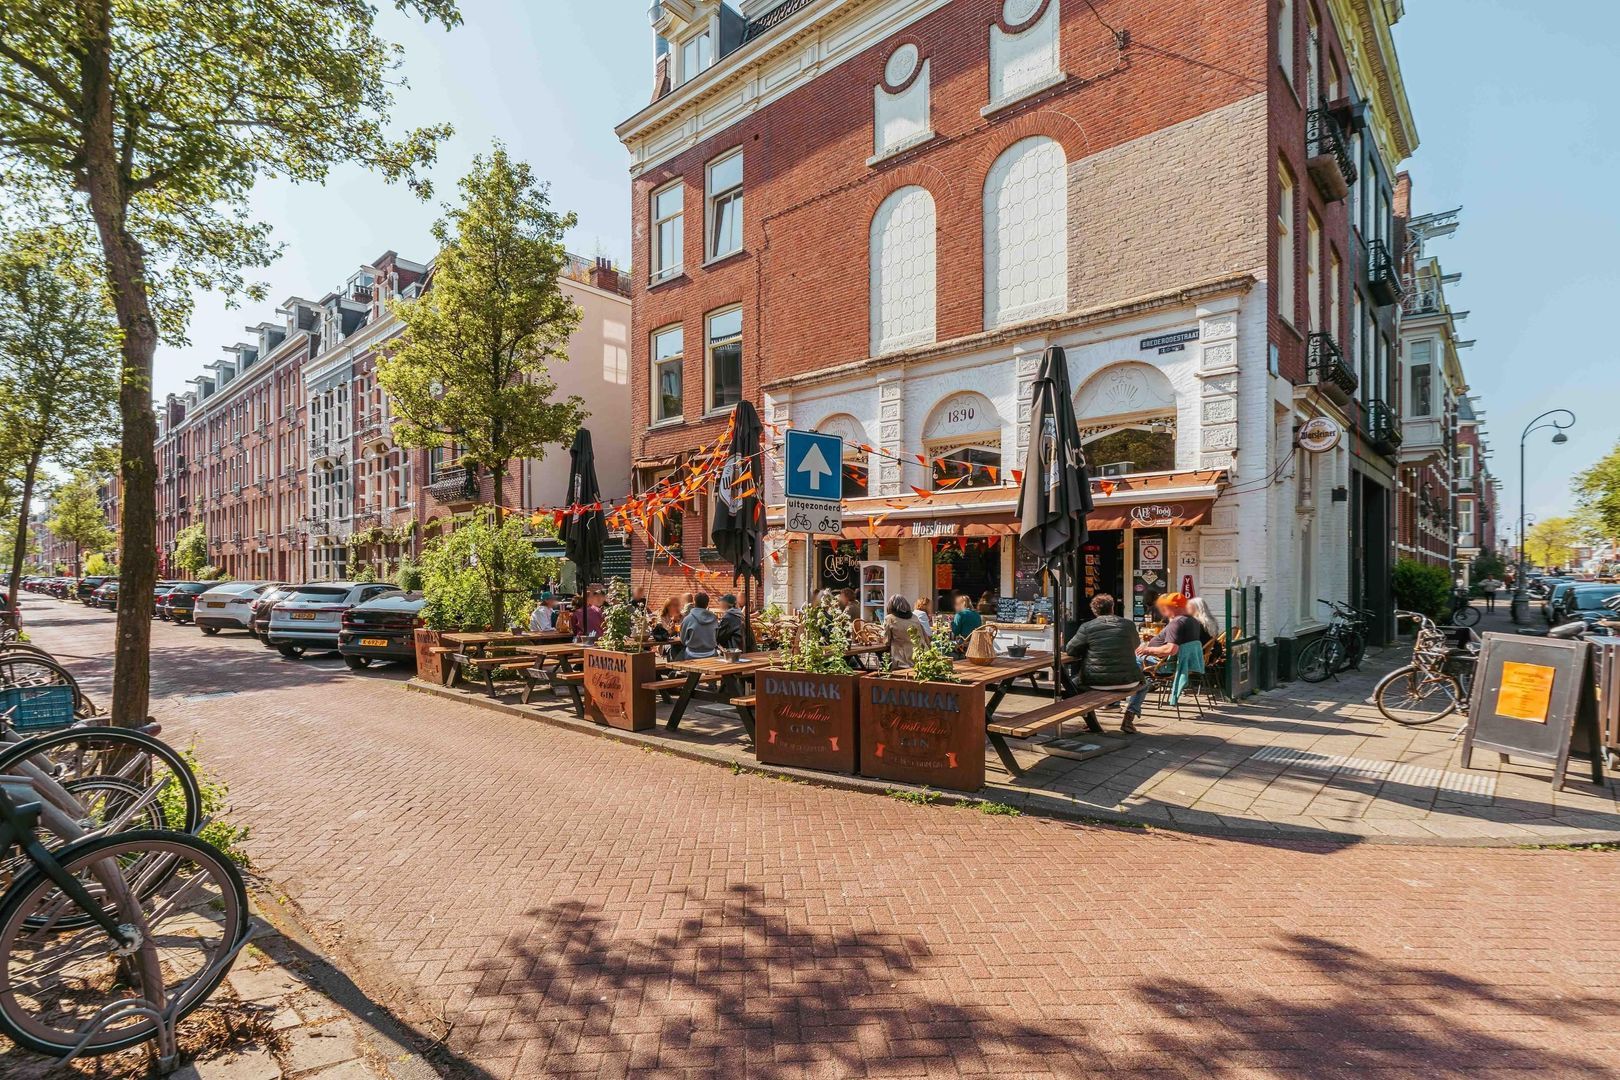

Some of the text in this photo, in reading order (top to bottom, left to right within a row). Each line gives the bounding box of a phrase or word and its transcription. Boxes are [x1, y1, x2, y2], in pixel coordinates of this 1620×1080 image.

[1142, 331, 1199, 348] BREDERODESTRAAT
[948, 407, 975, 423] 1890
[788, 500, 841, 512] uitgezonderd
[1182, 557, 1196, 565] 142
[588, 654, 627, 673] DAMRAK
[600, 691, 614, 699] GIN
[765, 676, 841, 700] DAMRAK
[871, 685, 960, 712] DAMRAK
[789, 724, 816, 734] GIN
